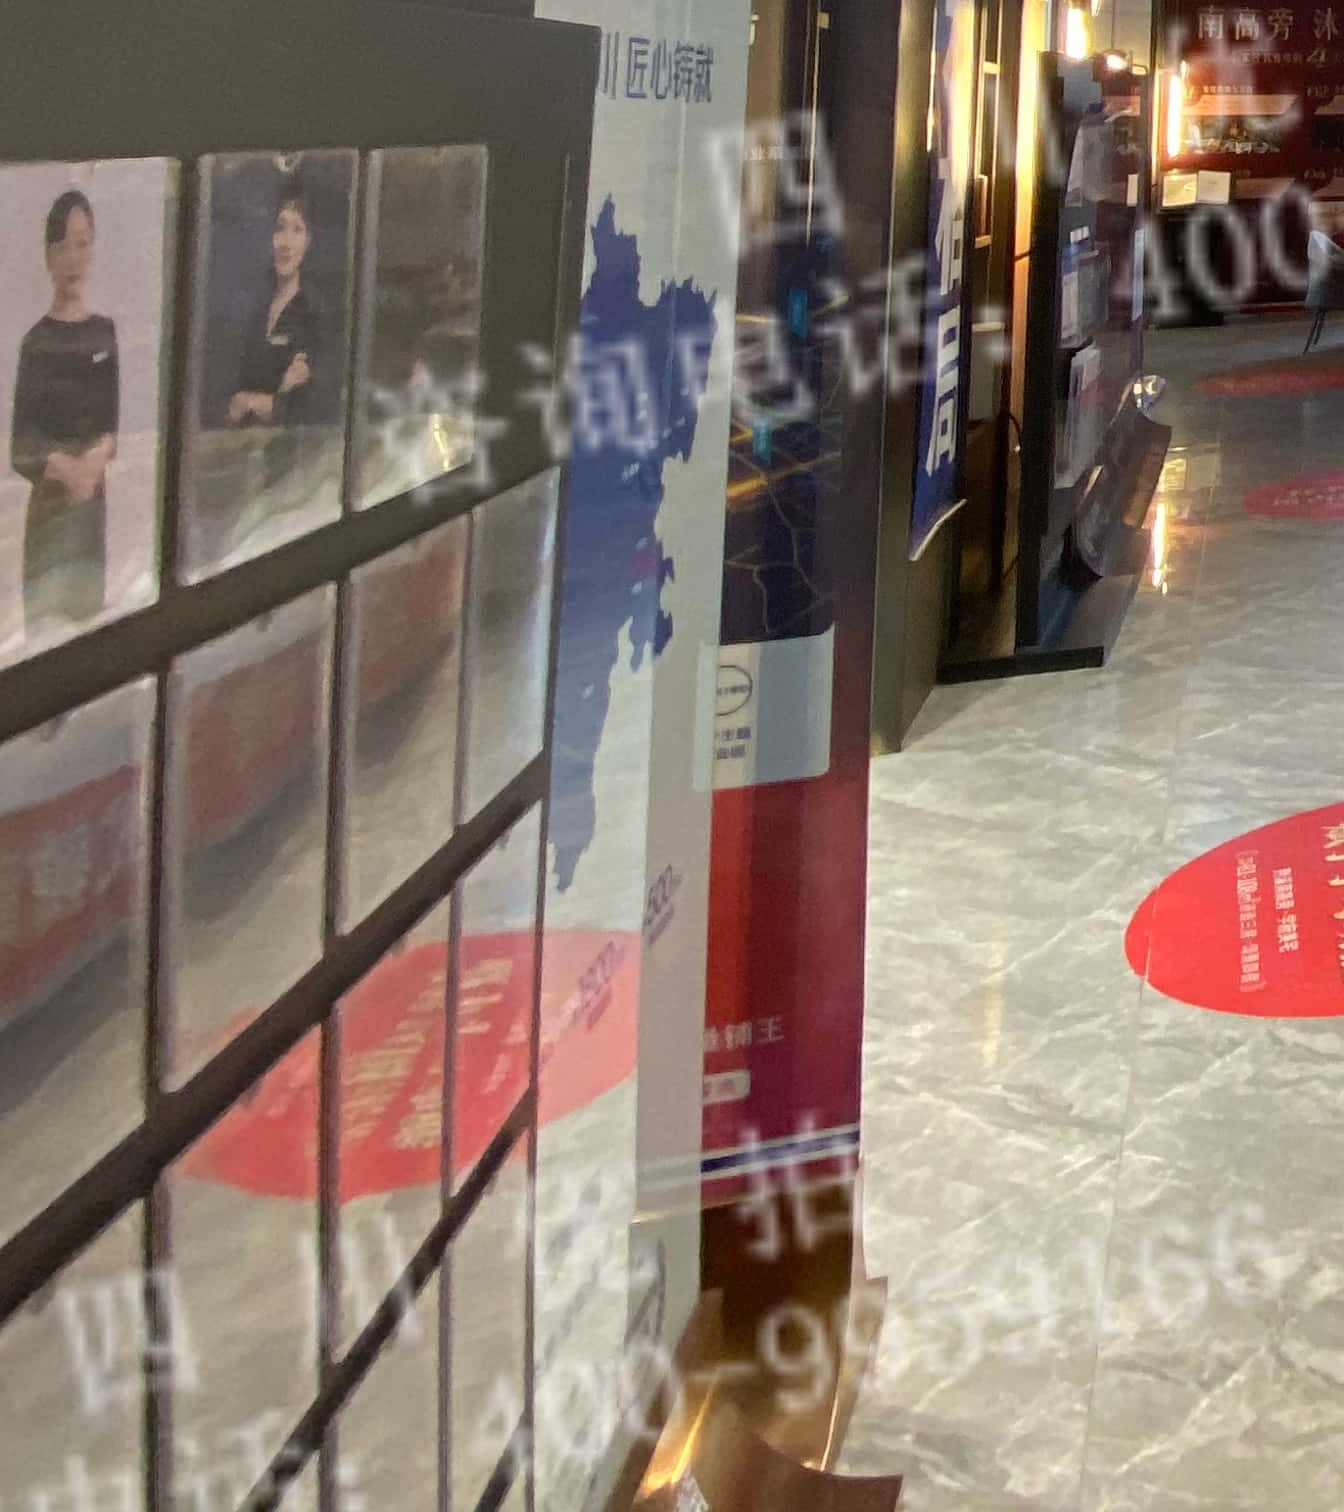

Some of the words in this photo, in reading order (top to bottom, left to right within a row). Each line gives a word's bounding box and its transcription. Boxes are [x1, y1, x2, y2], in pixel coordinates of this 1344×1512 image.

[1199, 5, 1294, 41] 南高旁
[625, 36, 715, 103] 匠心铸就
